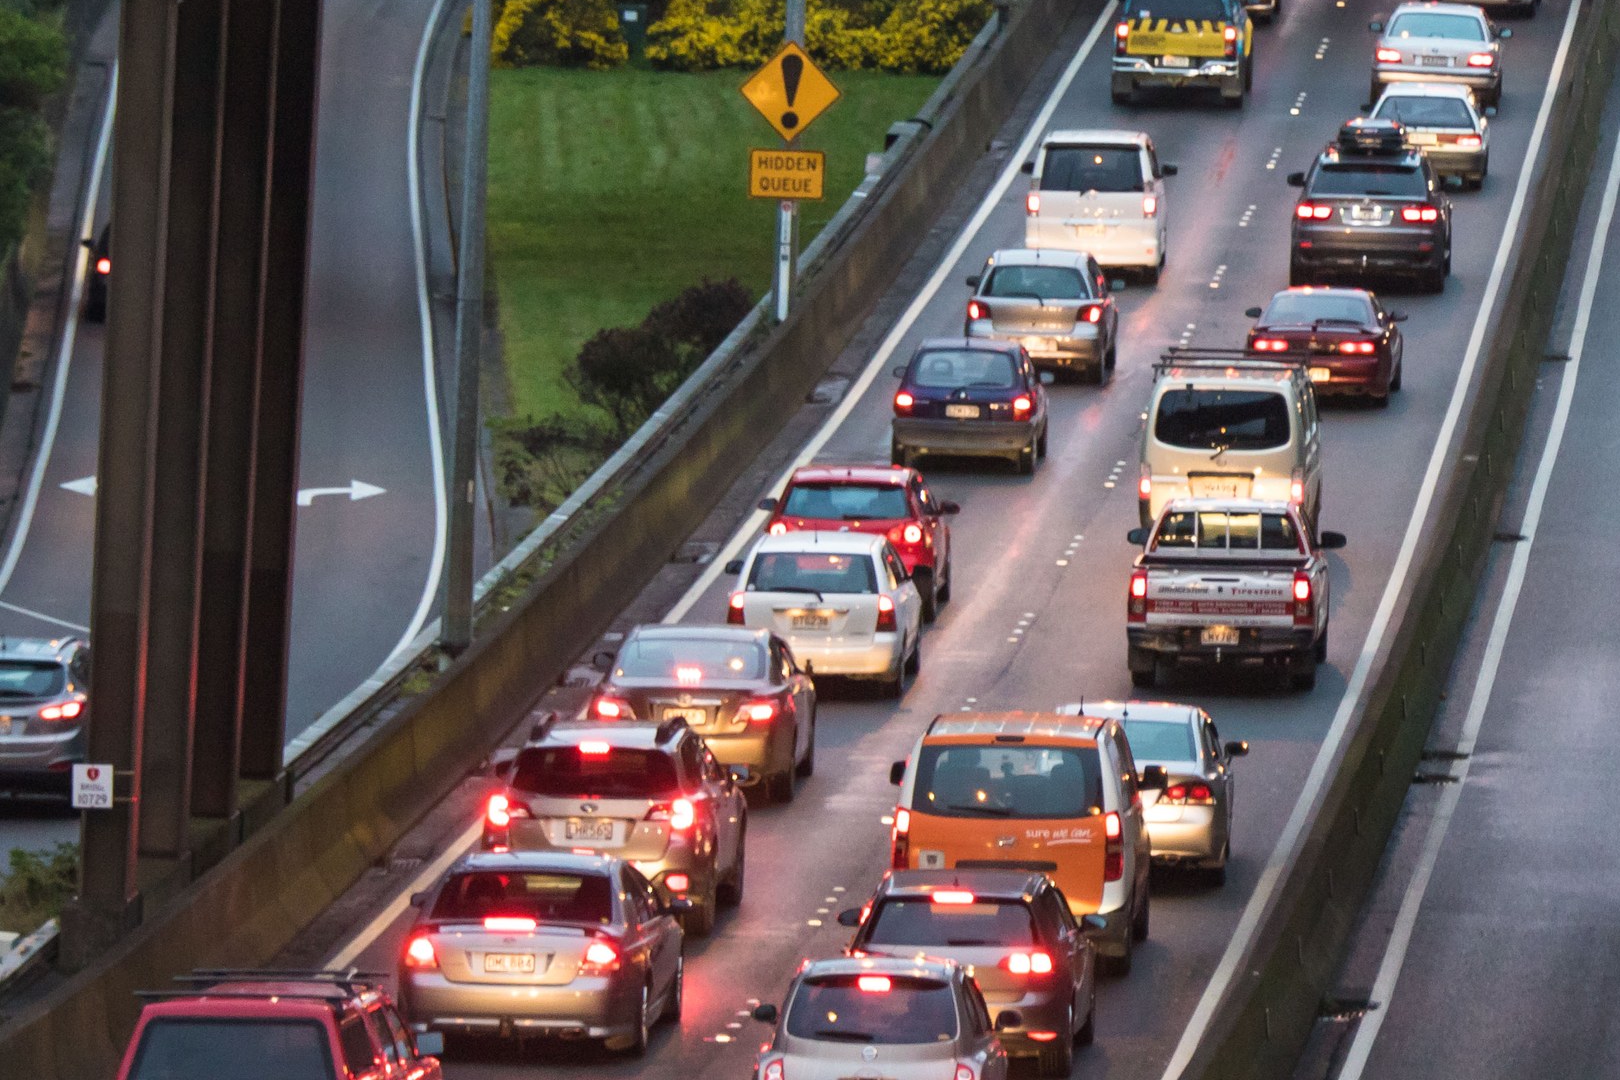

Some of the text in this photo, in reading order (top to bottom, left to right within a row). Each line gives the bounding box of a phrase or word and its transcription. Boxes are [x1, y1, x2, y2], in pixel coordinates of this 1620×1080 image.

[758, 156, 817, 171] HIDDEN
[760, 177, 812, 192] QUEUE
[1026, 829, 1050, 838] sure
[1053, 828, 1069, 839] we
